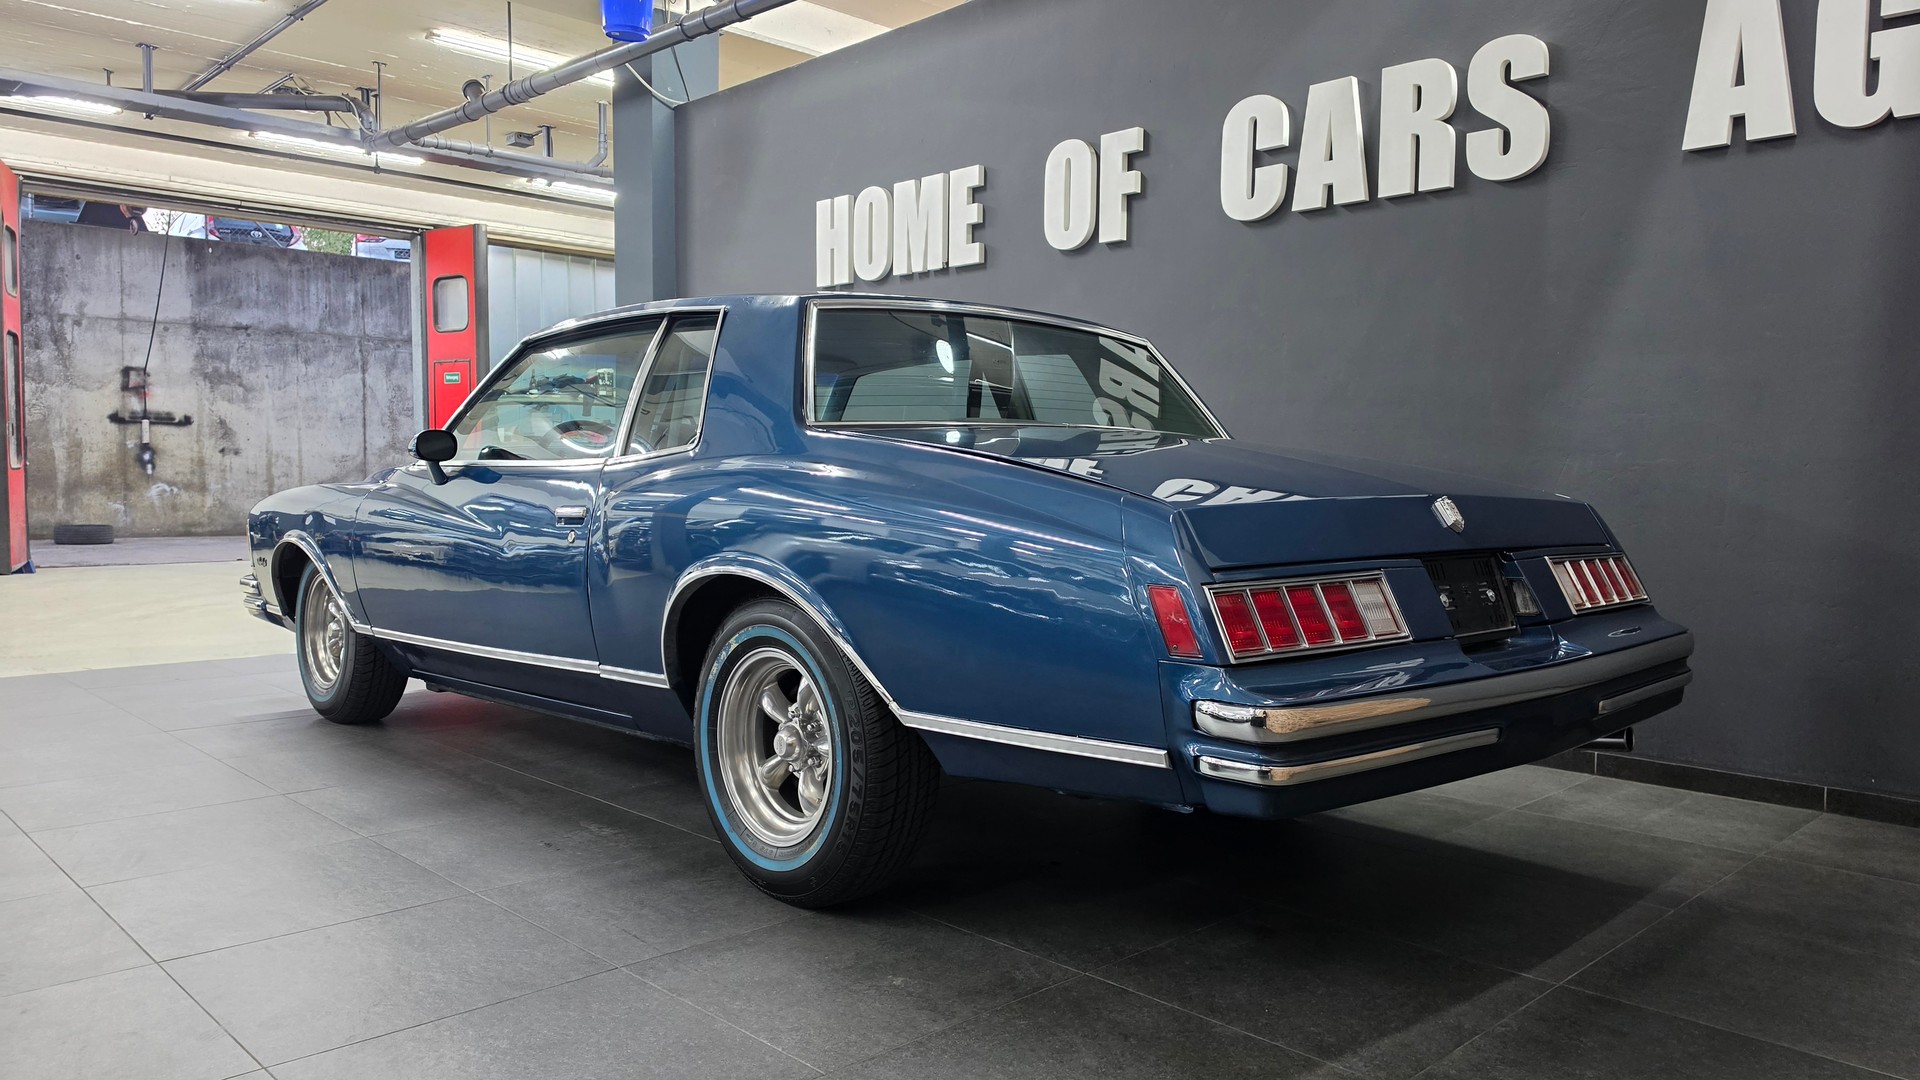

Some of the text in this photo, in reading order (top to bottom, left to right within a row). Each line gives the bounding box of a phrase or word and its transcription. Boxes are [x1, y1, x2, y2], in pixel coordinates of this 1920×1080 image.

[816, 0, 1920, 288] HOME OF CARS AG
